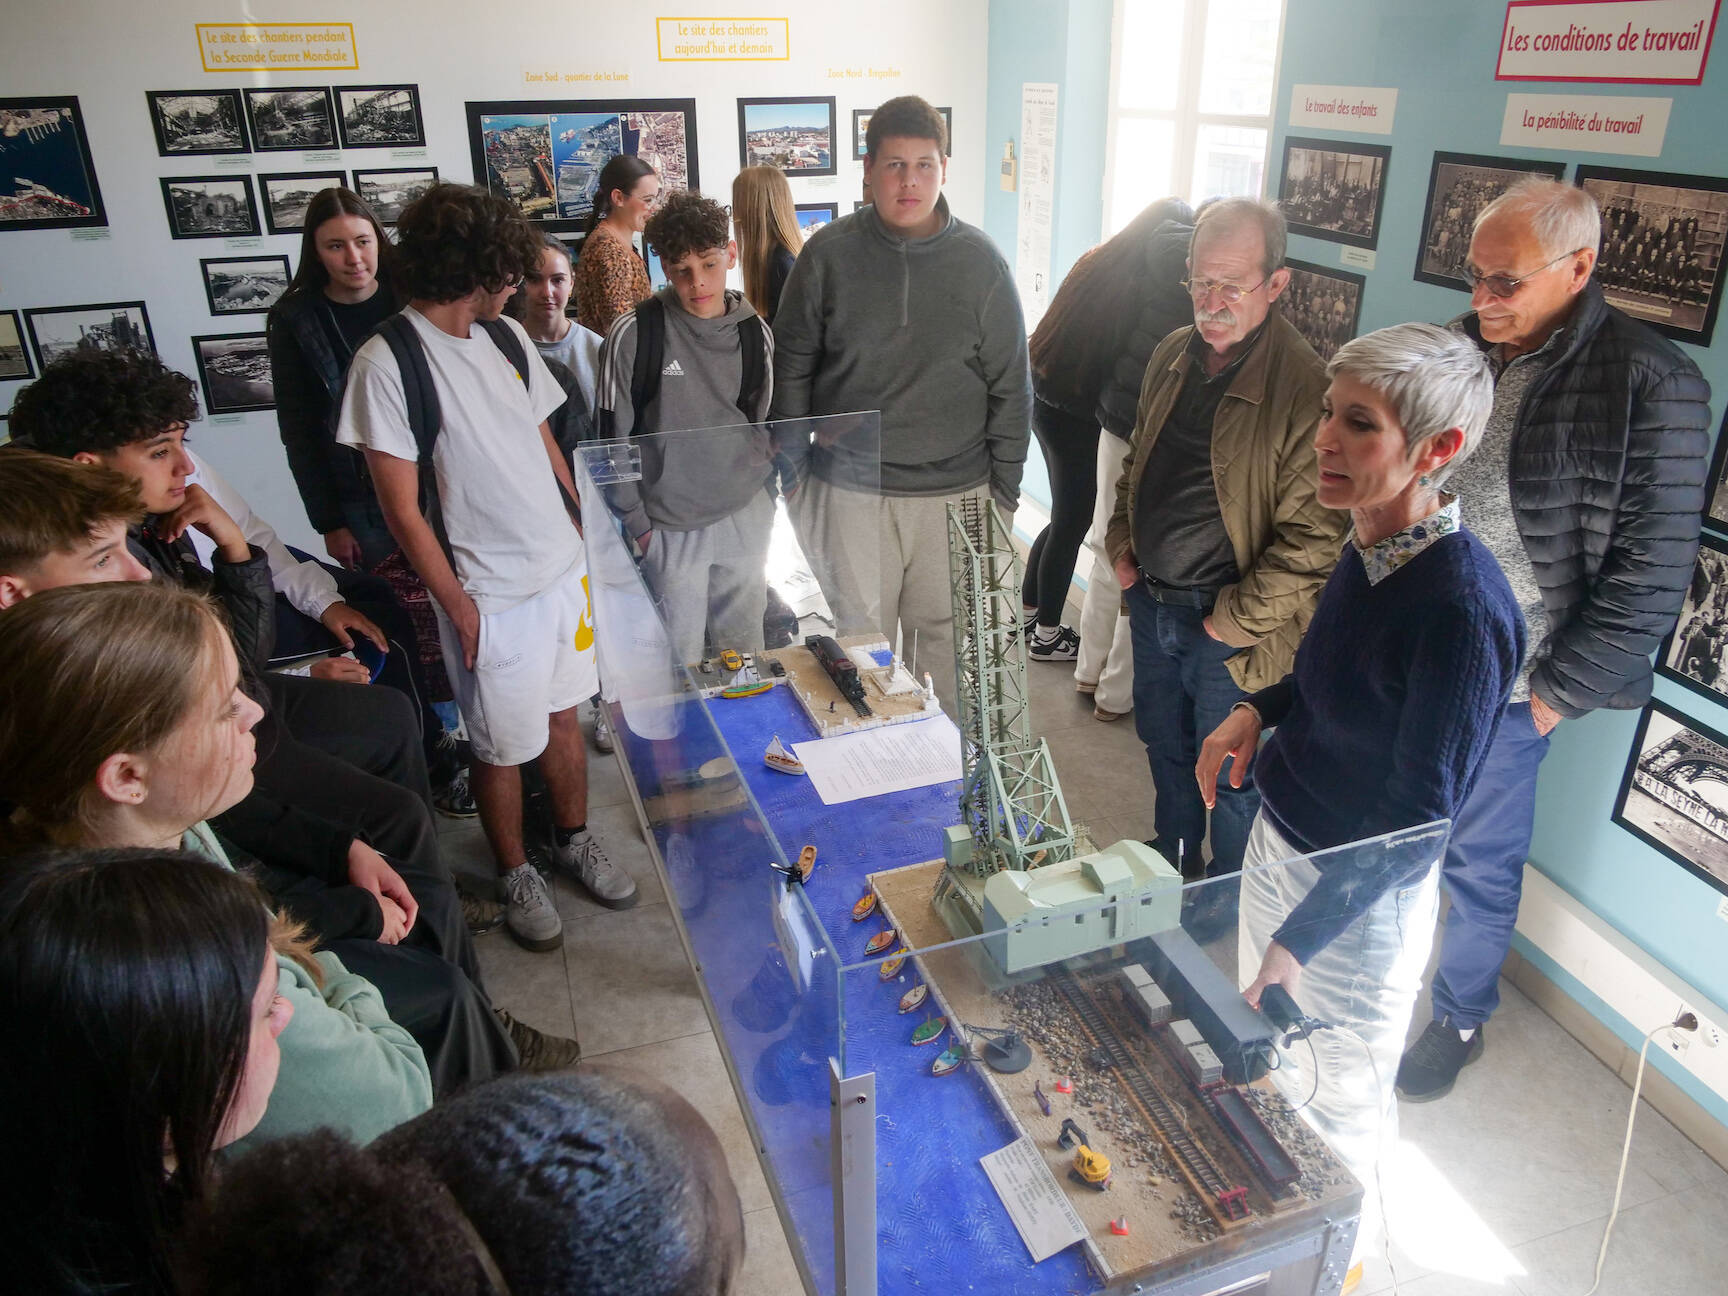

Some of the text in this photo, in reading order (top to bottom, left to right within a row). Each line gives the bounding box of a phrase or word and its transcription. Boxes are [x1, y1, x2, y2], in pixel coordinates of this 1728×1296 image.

[205, 28, 347, 45] Le site des chantiers pendant
[678, 22, 769, 36] Le site des chantiers
[1506, 19, 1705, 52] Les conditions de travail
[210, 48, 348, 64] la Seconde Guerre Mondiale
[674, 40, 774, 56] aujourd'hui et demain
[544, 71, 558, 82] Sud
[593, 71, 603, 81] de
[1305, 96, 1378, 119] Le travail des enfants
[1522, 109, 1644, 135] La pénibilité du travail
